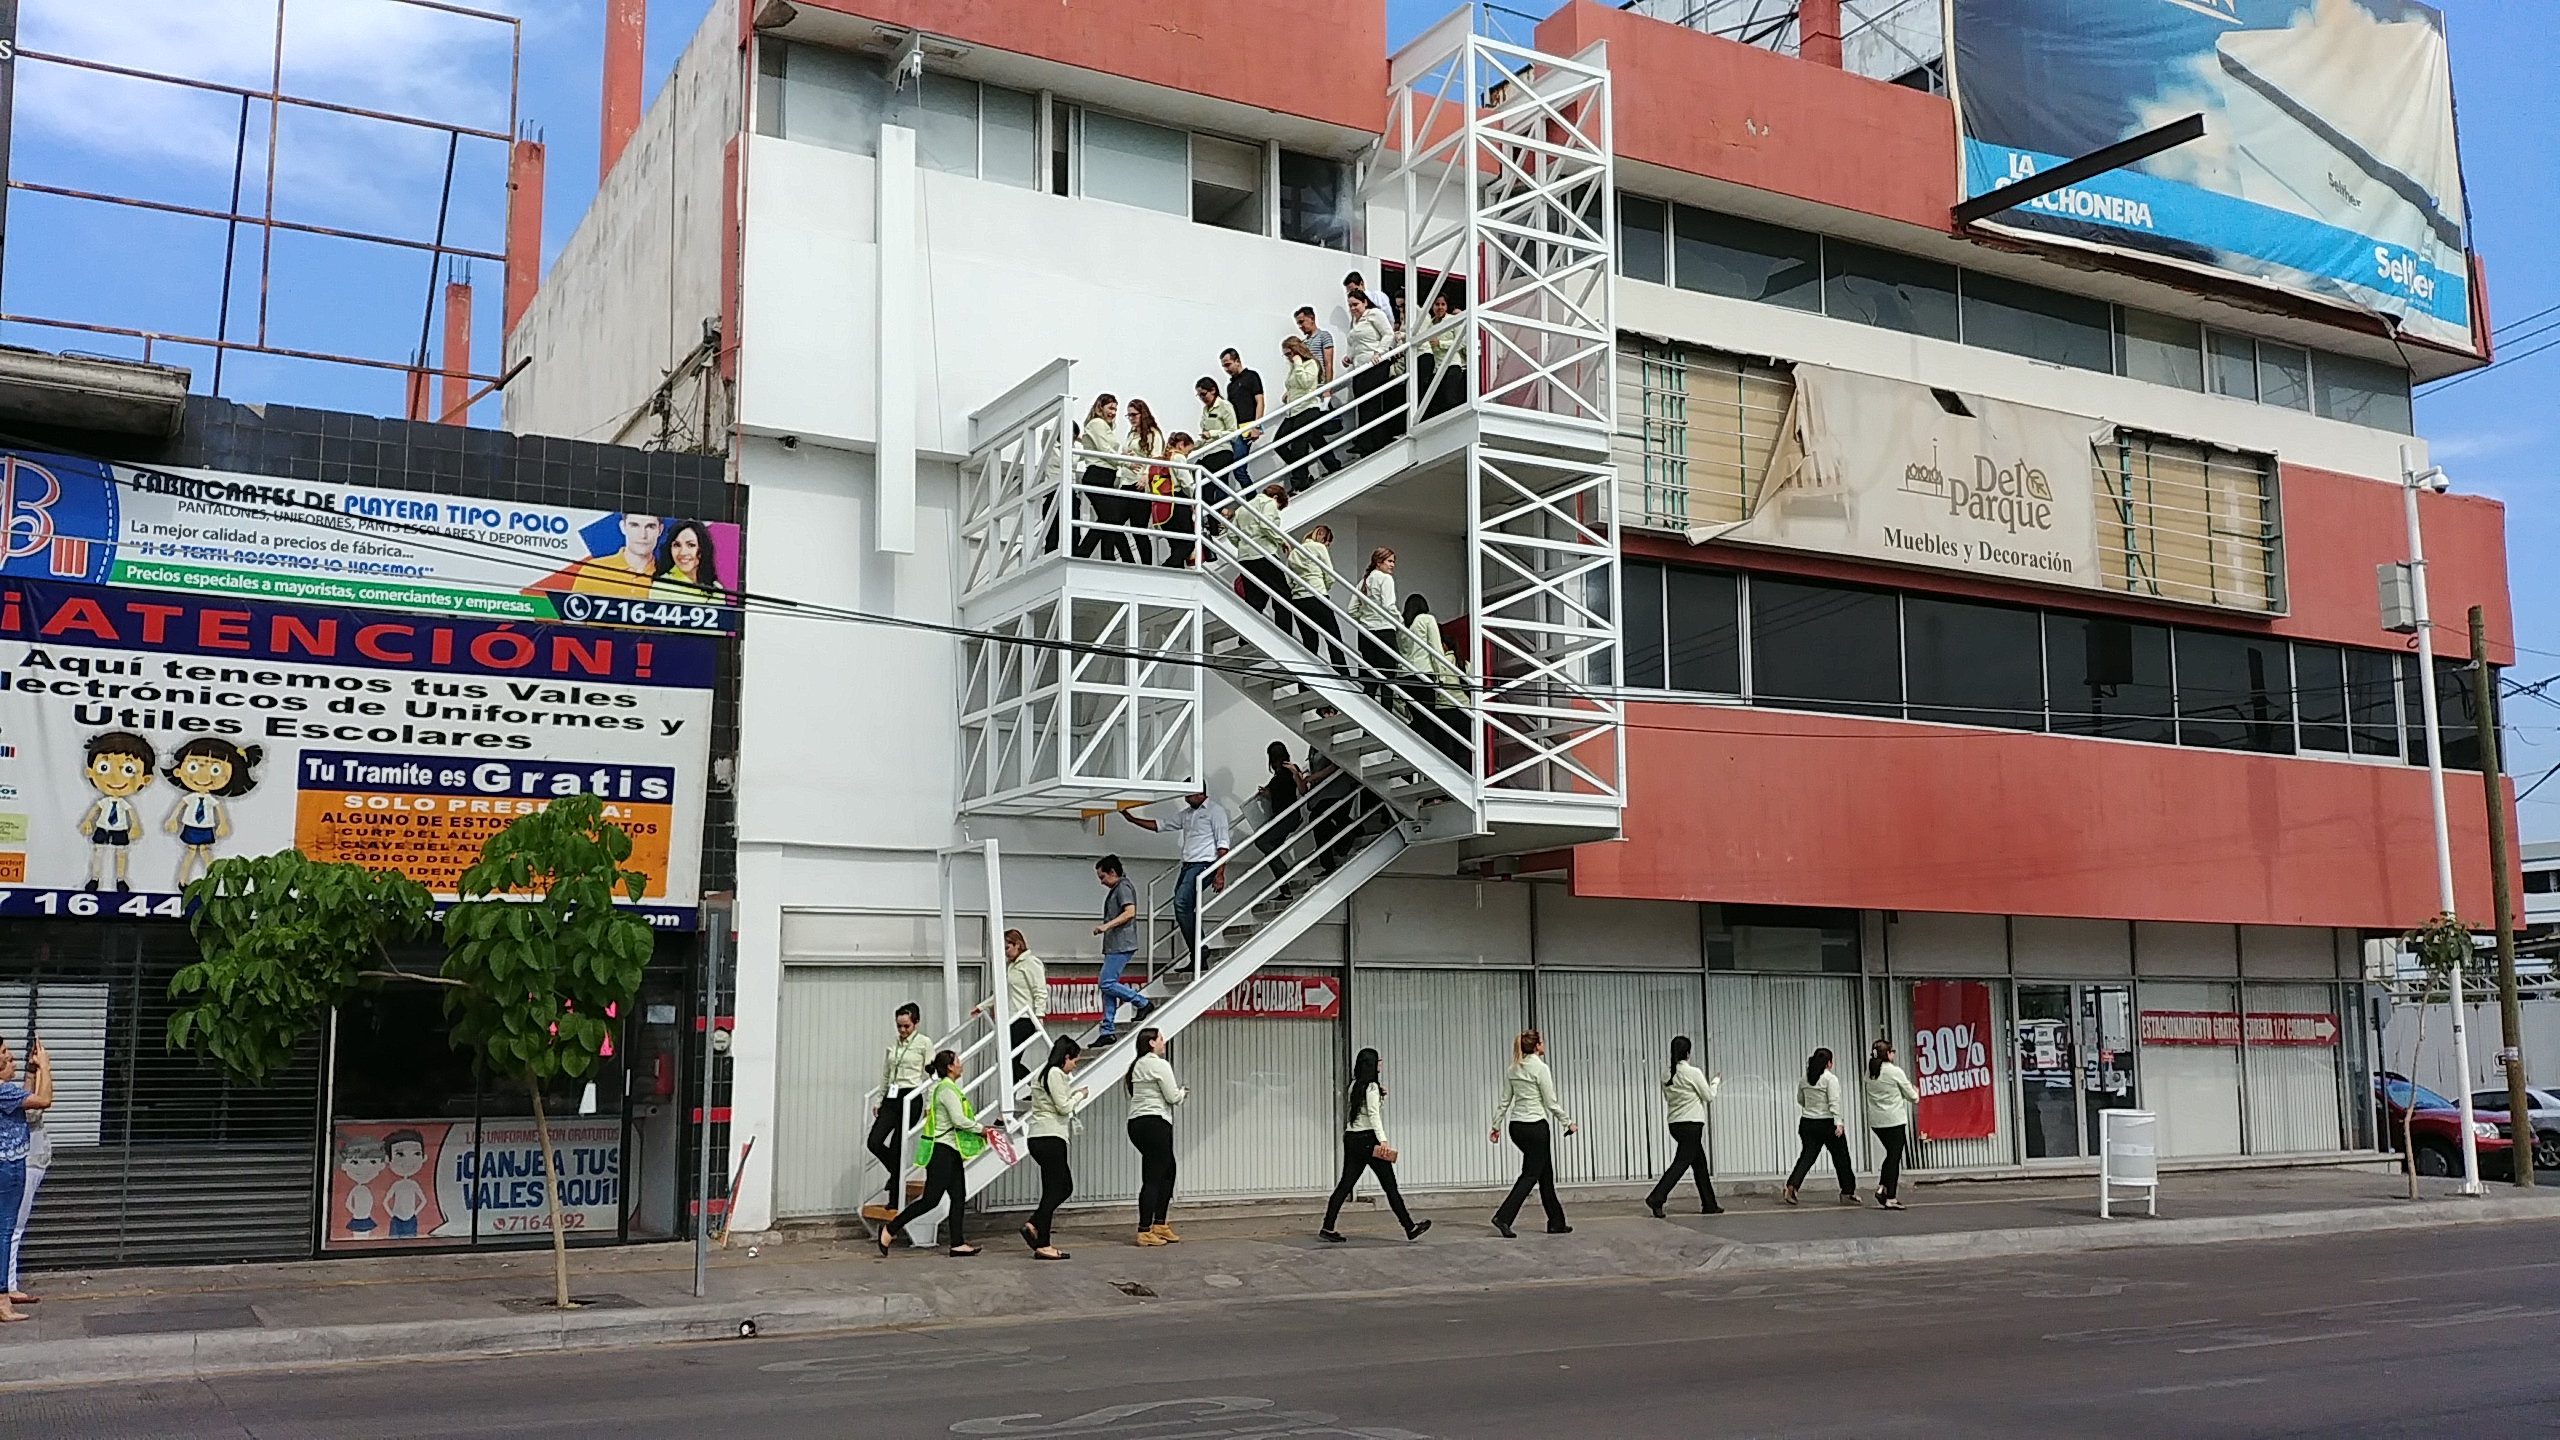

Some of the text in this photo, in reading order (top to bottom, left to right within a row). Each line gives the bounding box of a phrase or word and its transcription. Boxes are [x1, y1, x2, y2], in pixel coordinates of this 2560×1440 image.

[2008, 153, 2036, 179] LA
[1973, 454, 2024, 498] Del
[303, 490, 336, 511] DE
[343, 495, 438, 522] PLAYERA
[446, 504, 501, 528] TIPO
[509, 511, 569, 534] POLO
[1948, 478, 2052, 535] Parque
[130, 520, 414, 559] La mejor calidad a precios de fábrica...
[178, 501, 270, 522] PANTALONES,
[274, 509, 356, 531] UNIFORMES,
[358, 519, 400, 534] PANTS
[478, 530, 487, 541] Y
[489, 532, 569, 550] DEPORTIVOS
[233, 550, 319, 571] NOSOTROS
[1883, 526, 2073, 574] Muebles y Decoración
[126, 565, 535, 614] Precios especiales a mayoristas, comerciantes y empresas.
[593, 599, 719, 629] 7-16-44-92
[18, 647, 639, 709] Aquí tenemos tus Vales
[73, 700, 533, 751] Útiles Escolares
[327, 694, 387, 717] de
[405, 699, 646, 731] Uniformes
[659, 718, 686, 737] y
[305, 757, 669, 800] Tu Tramite es Gratis
[343, 795, 436, 812] SOLO
[321, 812, 514, 829] ALGUNO DE ESTOS
[403, 830, 441, 840] DEL
[413, 842, 450, 852] DEL
[426, 855, 463, 865] DEL
[34, 892, 99, 916] 16
[1253, 979, 1303, 1012] CUADRA
[2141, 1015, 2240, 1040] ESTACIONAMIENTO GRATIS
[1916, 1021, 1986, 1076] 30%
[1918, 1066, 1991, 1098] DESCUENTO
[487, 1128, 540, 1144] UNIFORME
[572, 1147, 619, 1176] TUS
[508, 1213, 585, 1231] 716492
